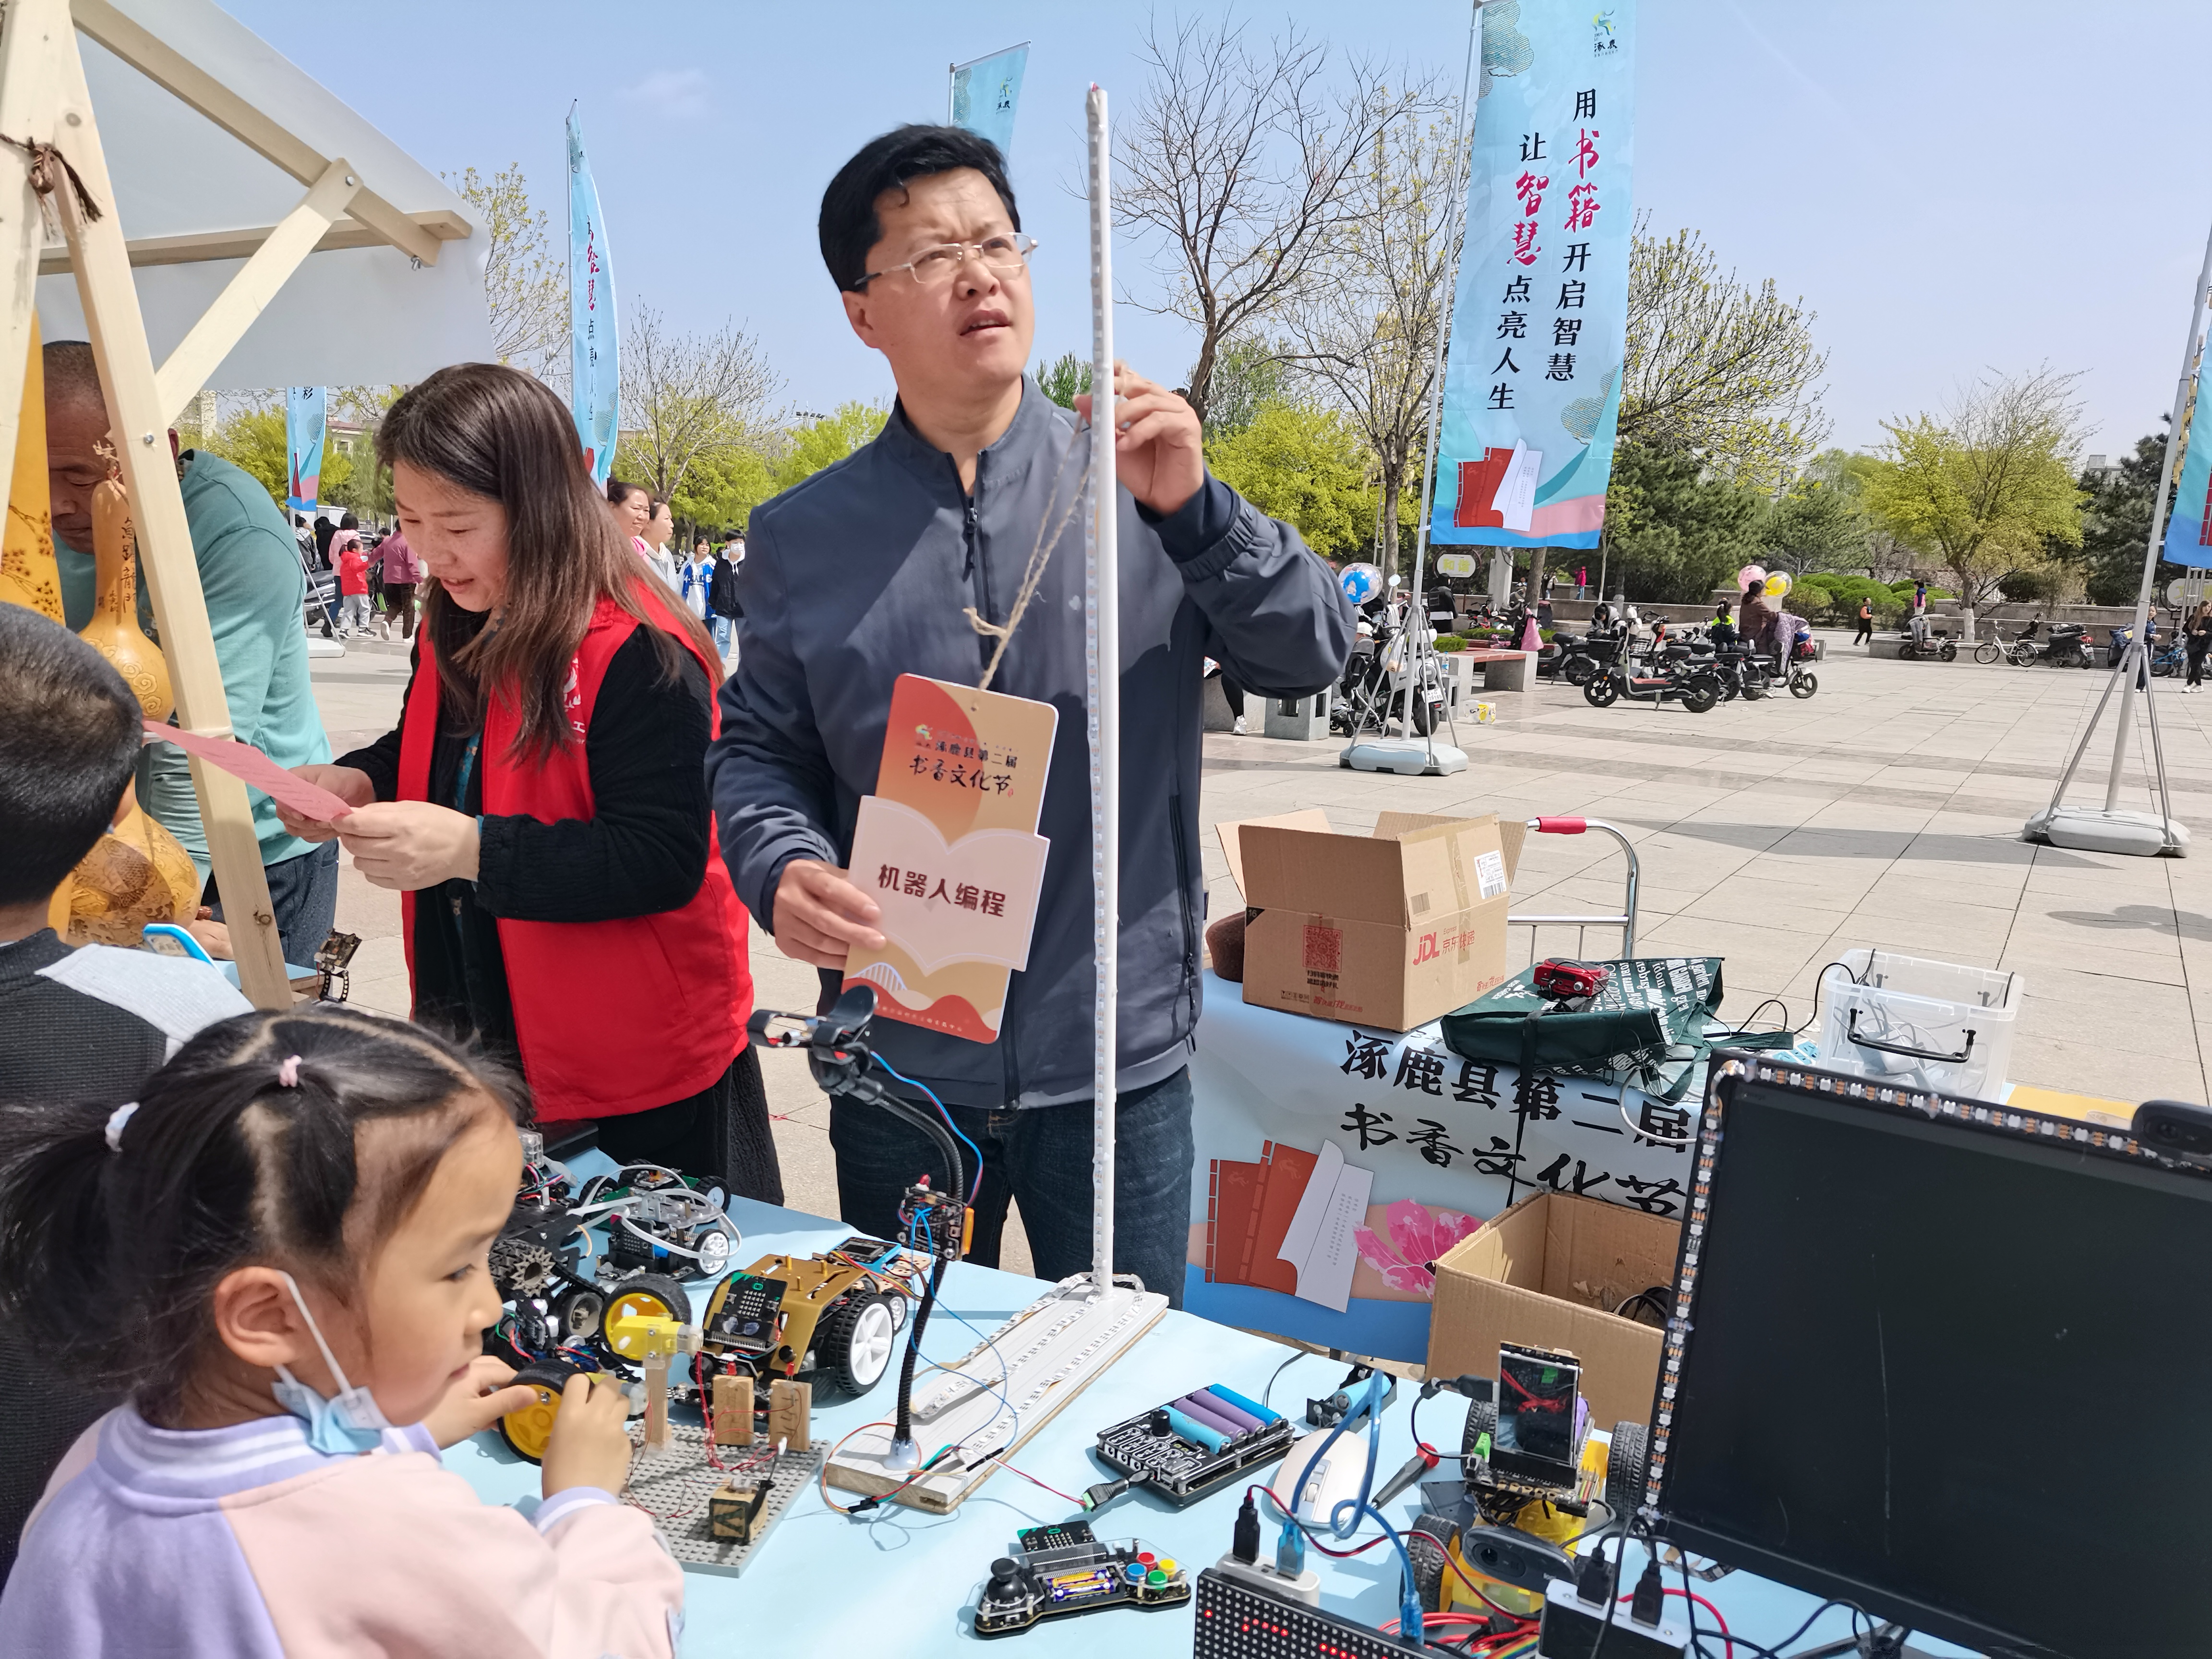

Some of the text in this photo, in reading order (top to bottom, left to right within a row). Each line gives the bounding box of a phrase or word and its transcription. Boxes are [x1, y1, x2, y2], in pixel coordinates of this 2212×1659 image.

[1545, 88, 1601, 381] 用书籍开启智慧
[1487, 132, 1549, 410] 让智慧点亮人生
[1443, 558, 1470, 572] 和谐
[935, 741, 1017, 768] 涿鹿县第二届
[910, 755, 1012, 795] 书香文化节
[878, 864, 1006, 917] 机器人编程
[1442, 930, 1475, 954] 京东快递
[1443, 926, 1457, 935] Express
[1669, 967, 1694, 995] GARDEN
[1688, 962, 1712, 988] garden
[1339, 1029, 1691, 1154] 涿鹿县第二届
[1340, 1104, 1688, 1215] 书香文化节
